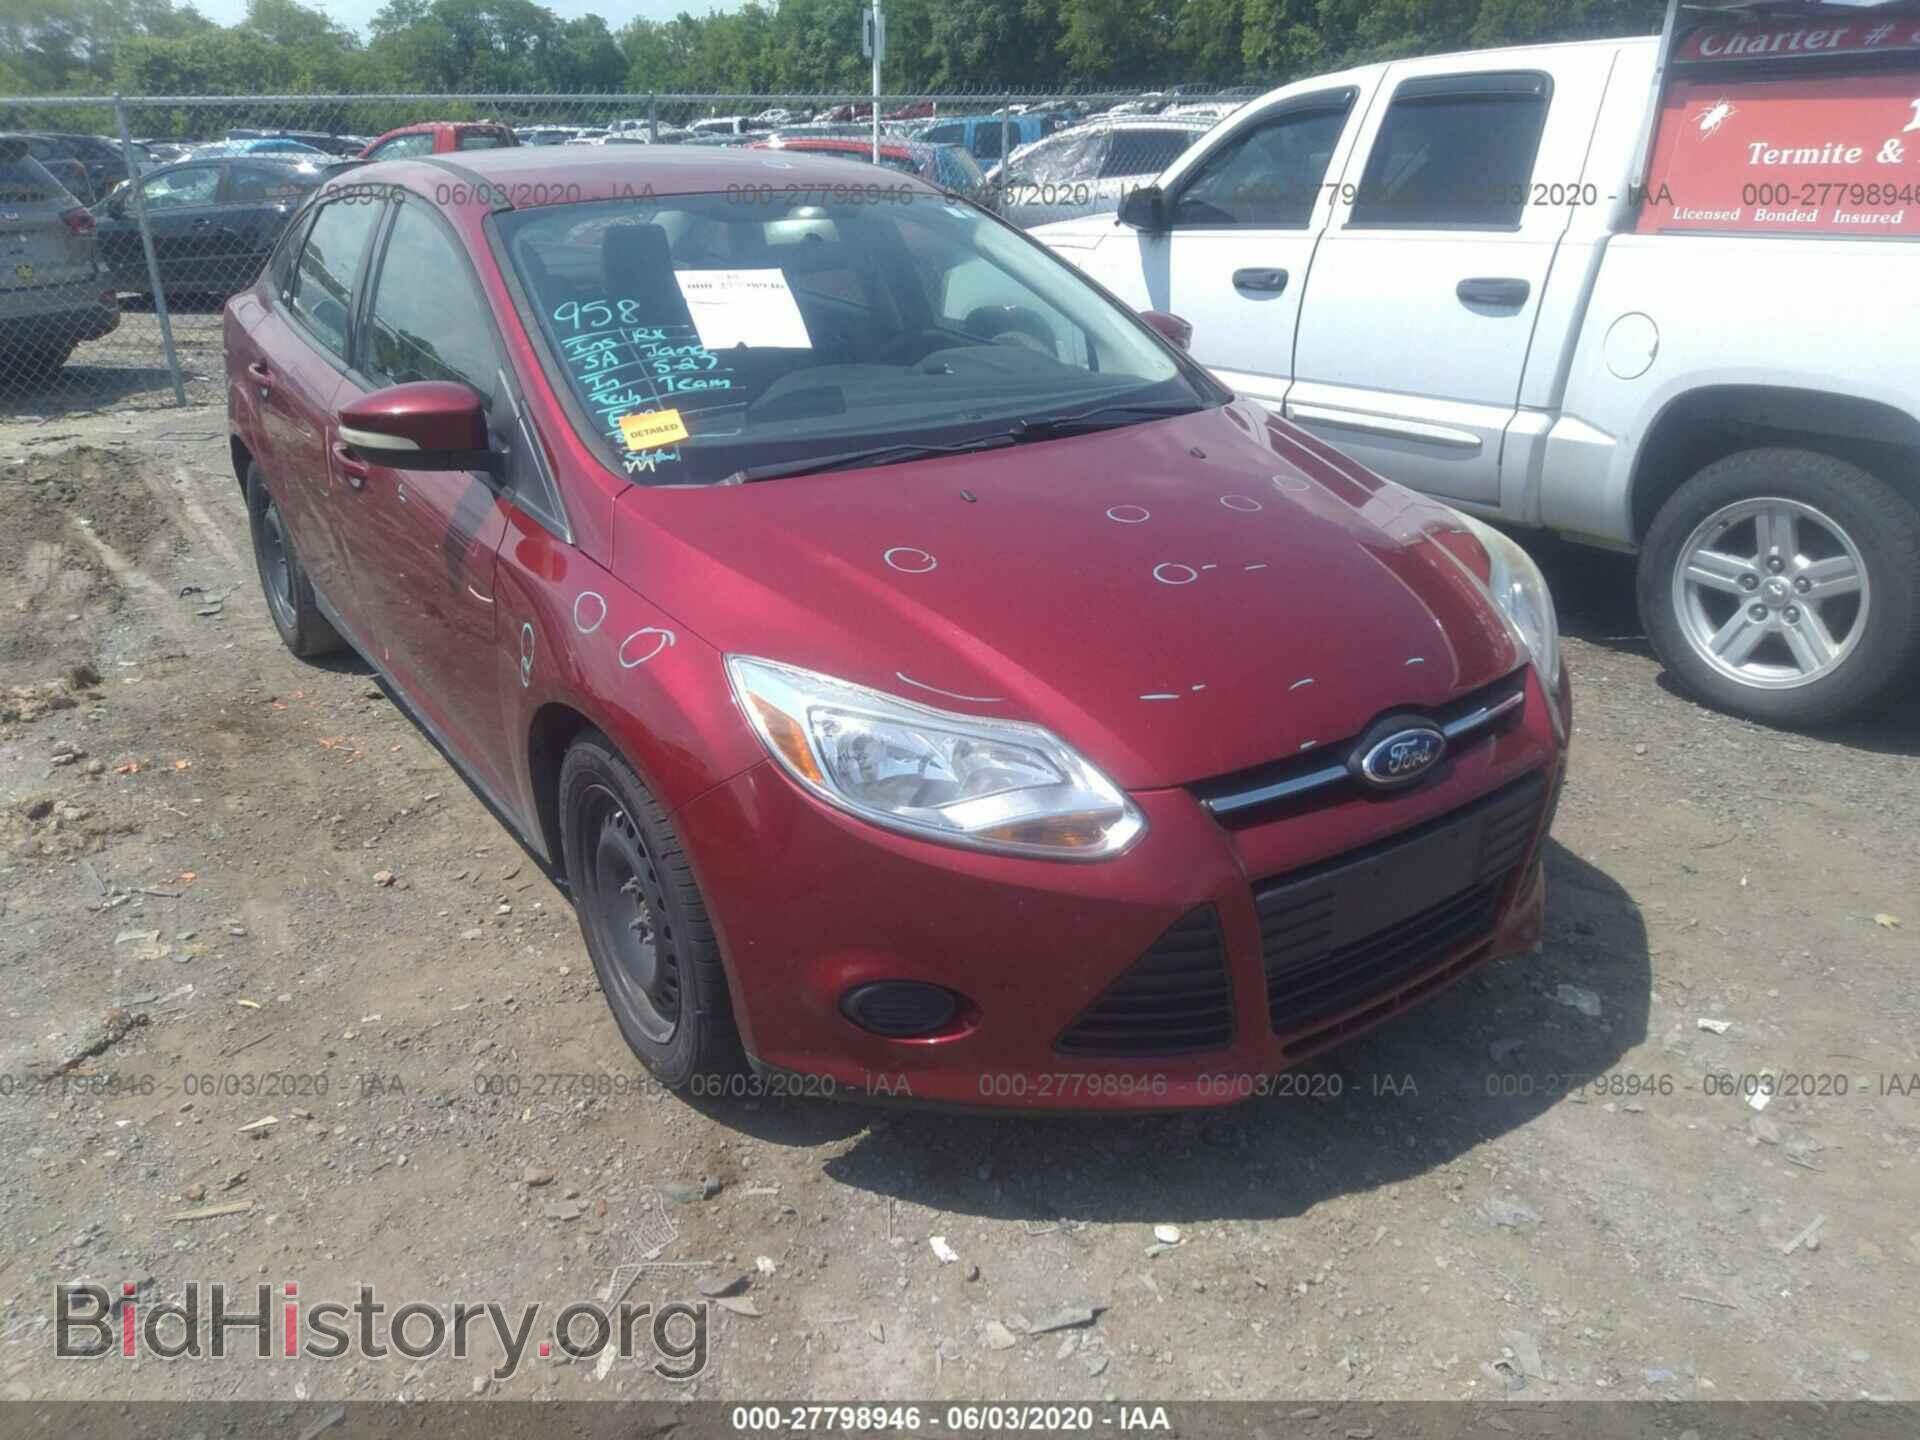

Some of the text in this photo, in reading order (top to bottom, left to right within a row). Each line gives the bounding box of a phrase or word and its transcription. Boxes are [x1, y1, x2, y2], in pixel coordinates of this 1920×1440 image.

[1699, 26, 1849, 57] Charter
[1748, 138, 1904, 165] Termite &
[1672, 206, 1904, 226] Licensed Bonded Insured
[553, 298, 641, 329] 958
[629, 422, 679, 439] DETAILED
[1388, 738, 1431, 774] Ford
